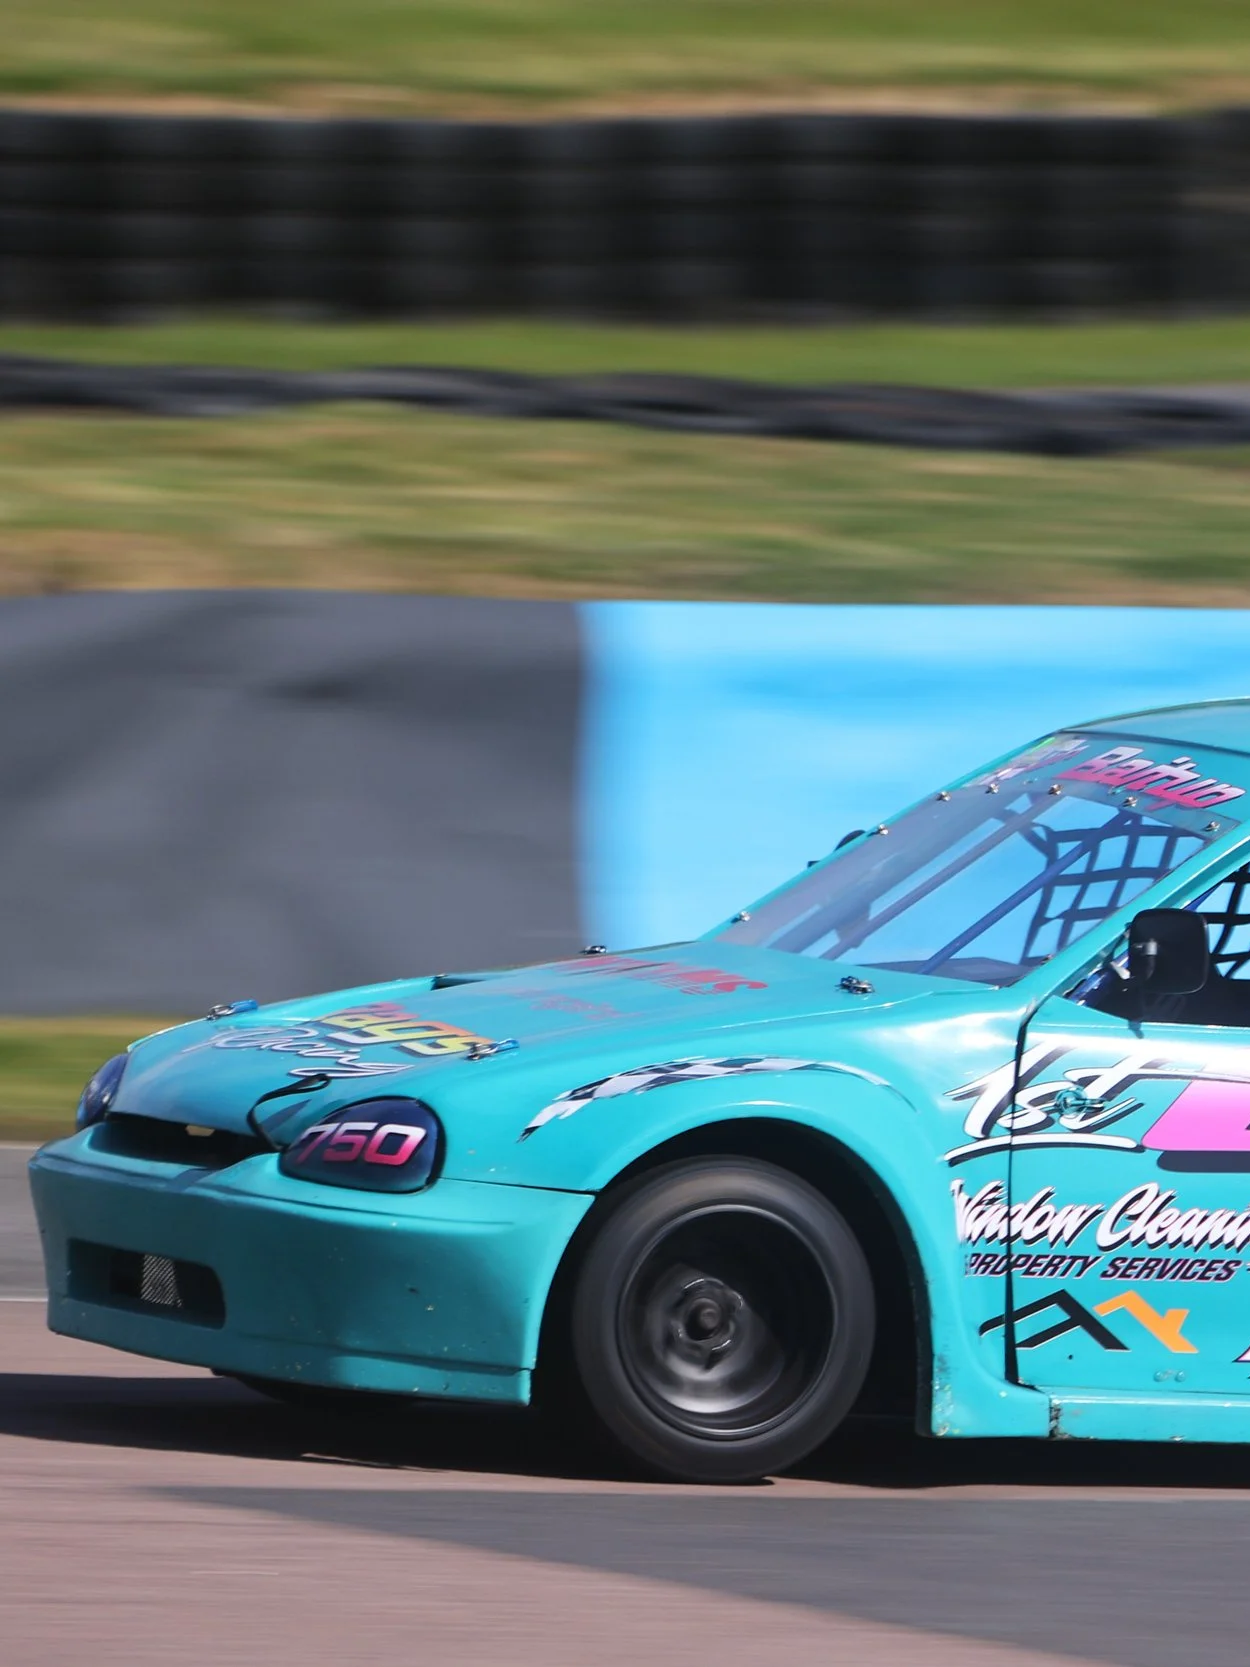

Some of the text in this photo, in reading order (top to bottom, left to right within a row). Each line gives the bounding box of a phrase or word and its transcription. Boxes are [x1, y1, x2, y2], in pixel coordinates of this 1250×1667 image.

[296, 1121, 427, 1166] 750
[950, 1179, 1106, 1249] Window
[1099, 1256, 1243, 1283] SERVICES
